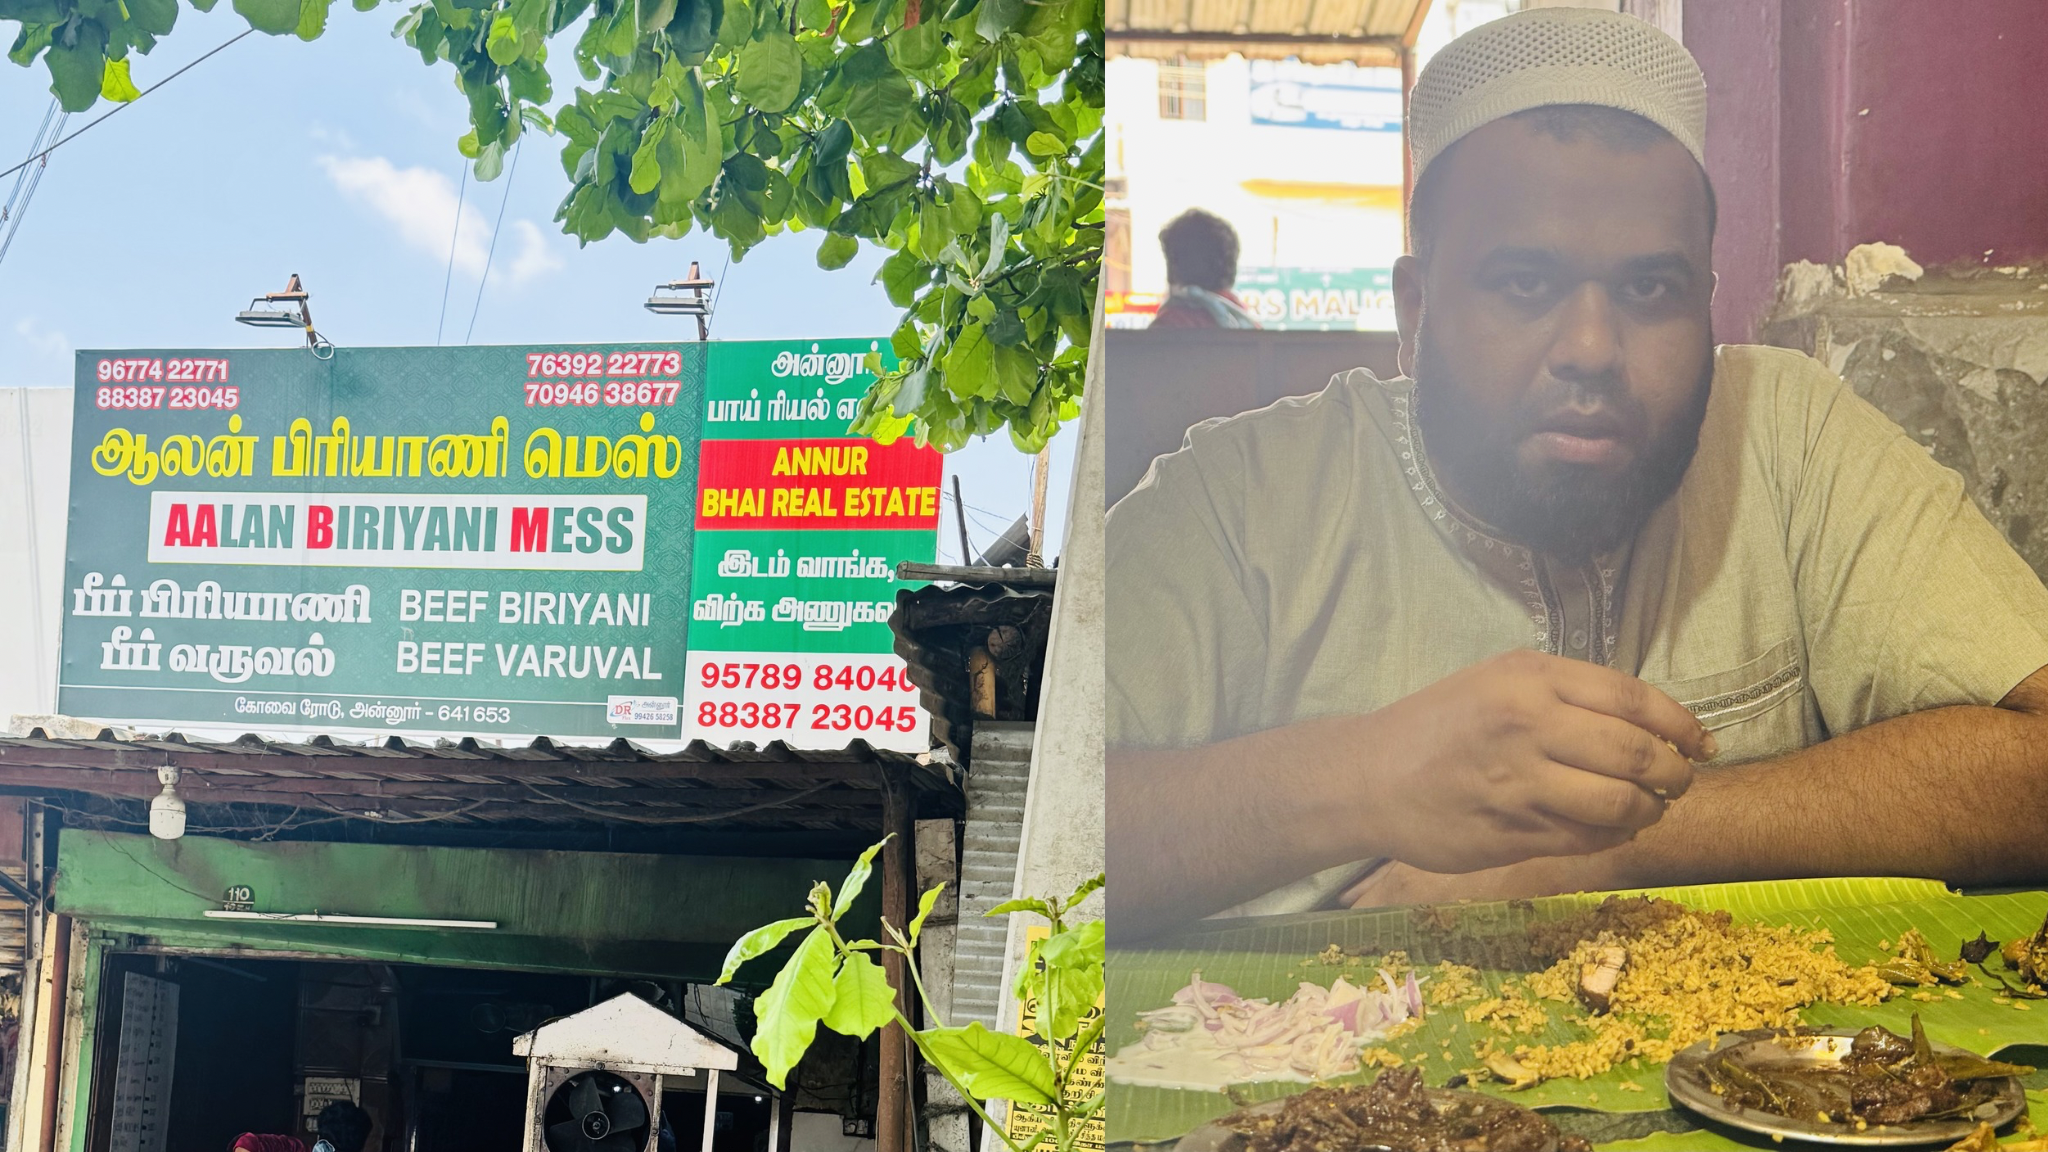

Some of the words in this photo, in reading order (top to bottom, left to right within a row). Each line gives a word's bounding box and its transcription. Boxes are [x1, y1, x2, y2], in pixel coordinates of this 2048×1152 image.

[98, 359, 162, 382] 96774
[167, 358, 229, 381] 22771
[527, 353, 602, 377] 76392
[606, 351, 682, 376] 22773
[97, 387, 165, 410] 88387
[170, 386, 239, 410] 23045
[525, 382, 600, 406] 70946
[604, 380, 682, 406] 38677
[707, 388, 761, 422] பாய்
[91, 413, 260, 486] ஆலன்
[272, 415, 510, 478] பிரியாணி
[524, 411, 682, 479] மெஸ்
[771, 446, 869, 476] ANNUR
[702, 488, 766, 517] BHAI
[771, 487, 838, 517] REAL
[844, 486, 937, 517] ESTATE
[164, 503, 295, 549] AALAN
[306, 505, 498, 551] BIRIYANI
[510, 506, 634, 554] MESS
[718, 548, 790, 578] இடம்
[796, 548, 896, 583] வாங்க,
[72, 572, 134, 617] பீப்
[139, 578, 372, 624] பிரியாணி
[399, 589, 489, 623] BEEF
[498, 590, 651, 626] BIRIYANI
[693, 592, 766, 630] விற்க
[100, 625, 162, 671] பீப்
[169, 631, 336, 684] வருவல்
[396, 640, 486, 676] BEEF
[494, 643, 663, 680] VARUVAL
[700, 662, 802, 690] 95789
[234, 696, 296, 715] கோவை
[299, 698, 344, 720] ரோடு,
[349, 700, 422, 725] அன்னூர்
[615, 704, 632, 716] DR
[697, 701, 802, 729] 88387
[810, 703, 917, 732] 23045
[228, 886, 250, 902] 110
